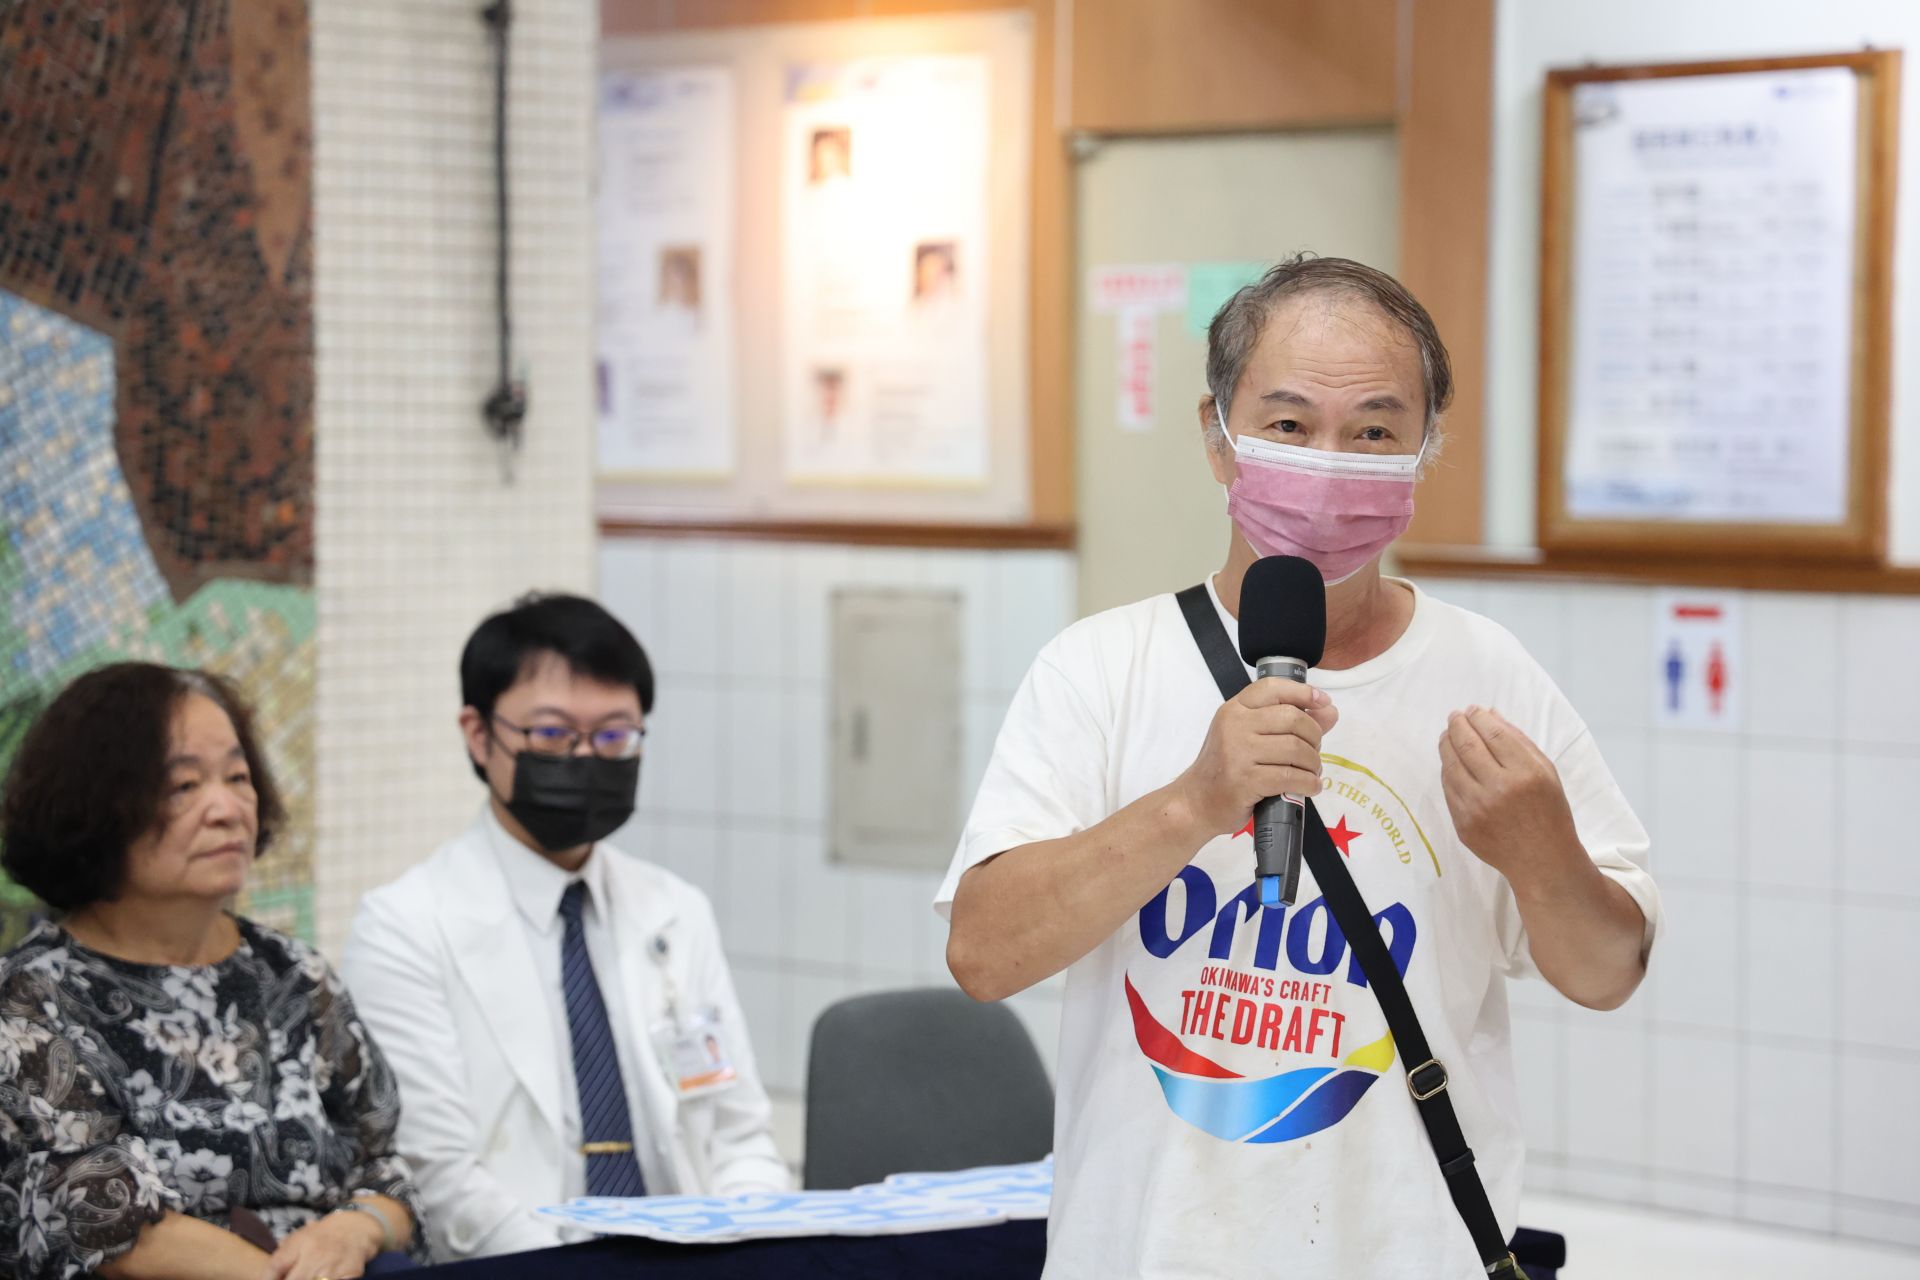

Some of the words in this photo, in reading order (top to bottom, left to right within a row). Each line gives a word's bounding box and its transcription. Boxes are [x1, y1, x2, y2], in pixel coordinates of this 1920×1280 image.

[1321, 776, 1333, 791] O
[1337, 781, 1370, 809] THE
[1371, 803, 1412, 865] WORLD
[1200, 966, 1275, 998] OKINAWA'S
[1279, 980, 1332, 1004] CRAFT
